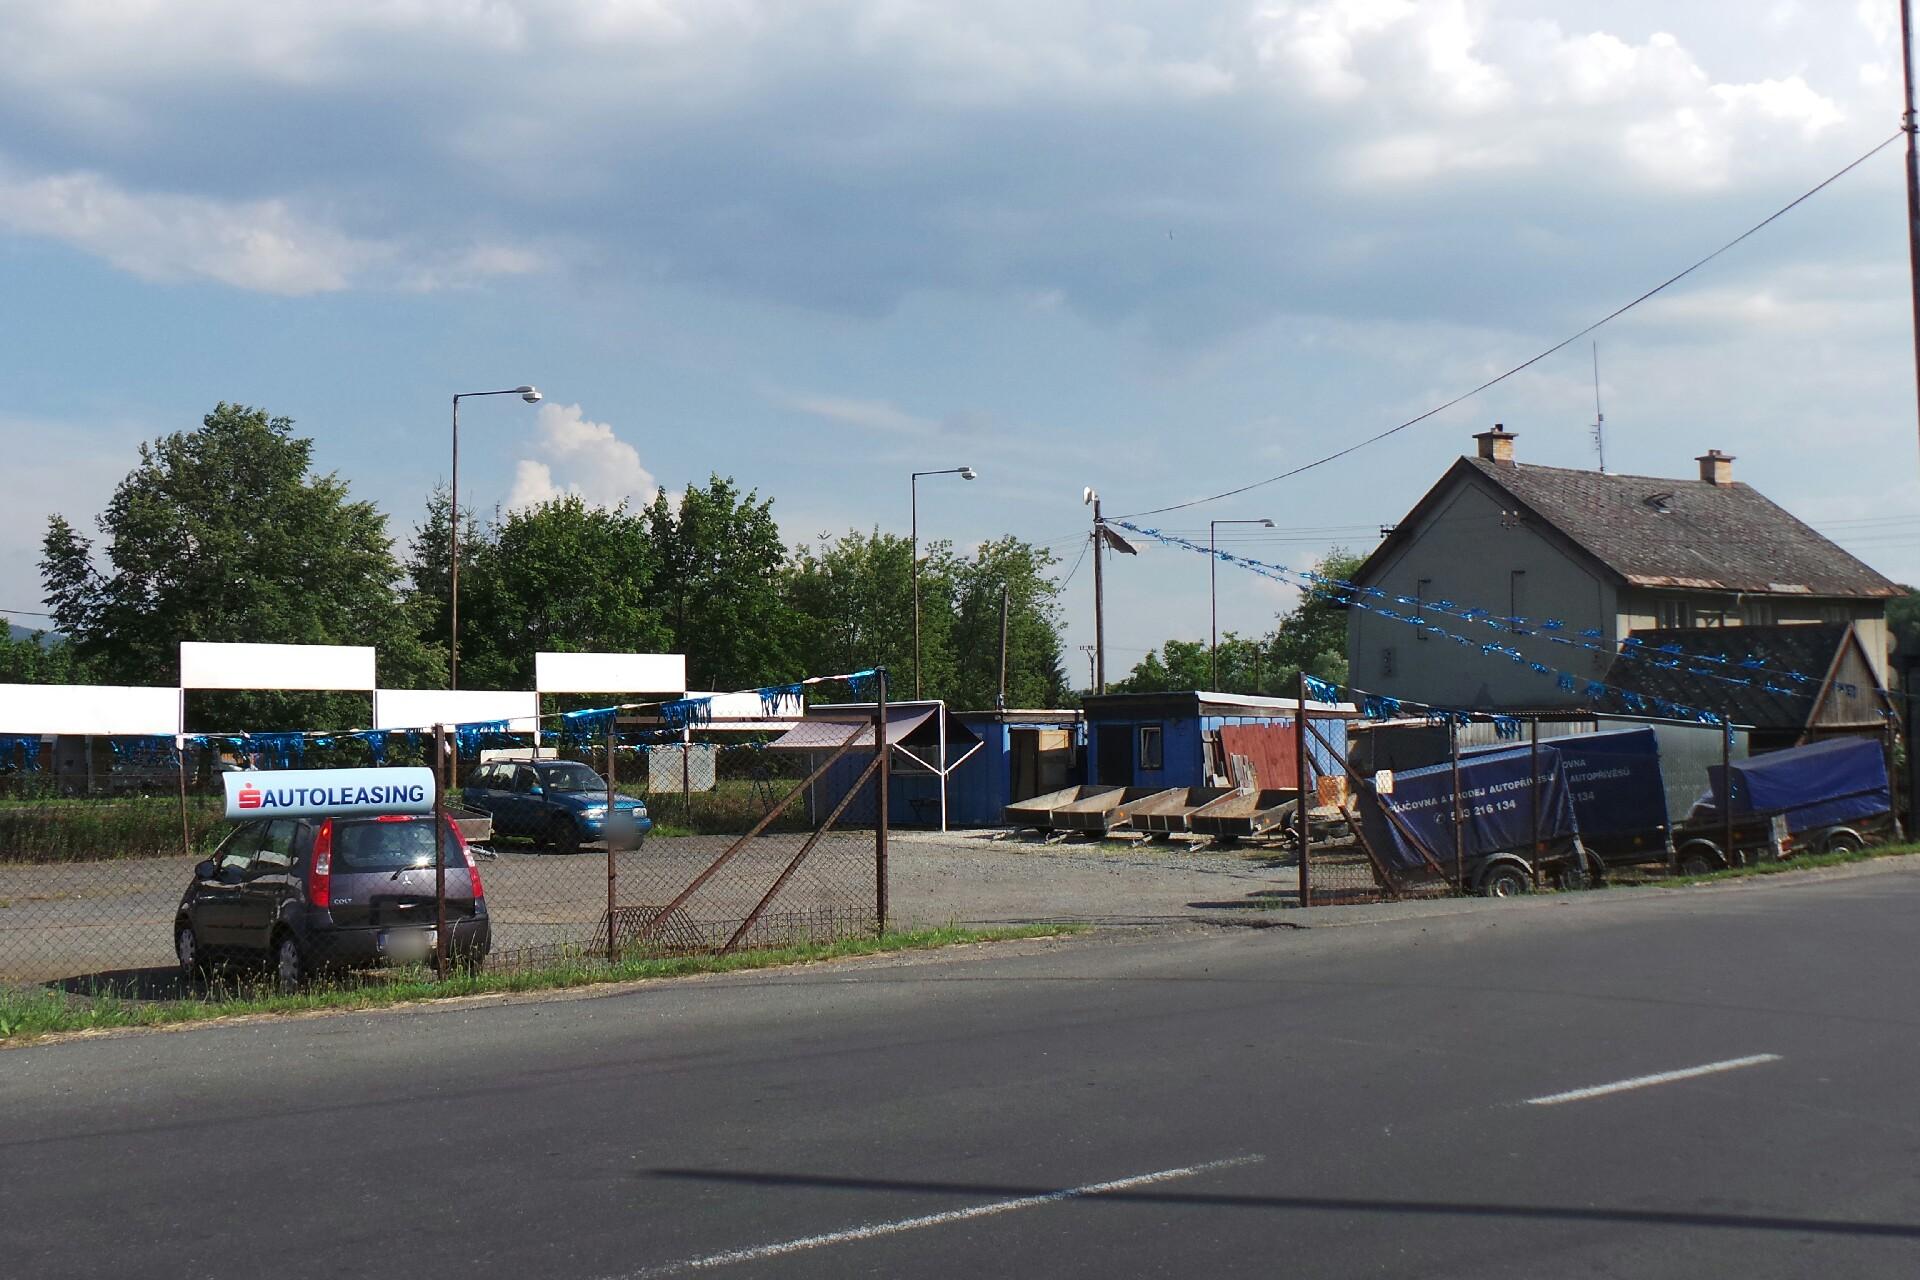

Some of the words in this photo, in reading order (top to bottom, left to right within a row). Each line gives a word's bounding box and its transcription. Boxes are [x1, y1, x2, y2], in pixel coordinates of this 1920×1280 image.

[261, 784, 424, 808] AUTOLEASING
[1473, 804, 1494, 816] 216
[1496, 799, 1516, 811] 134
